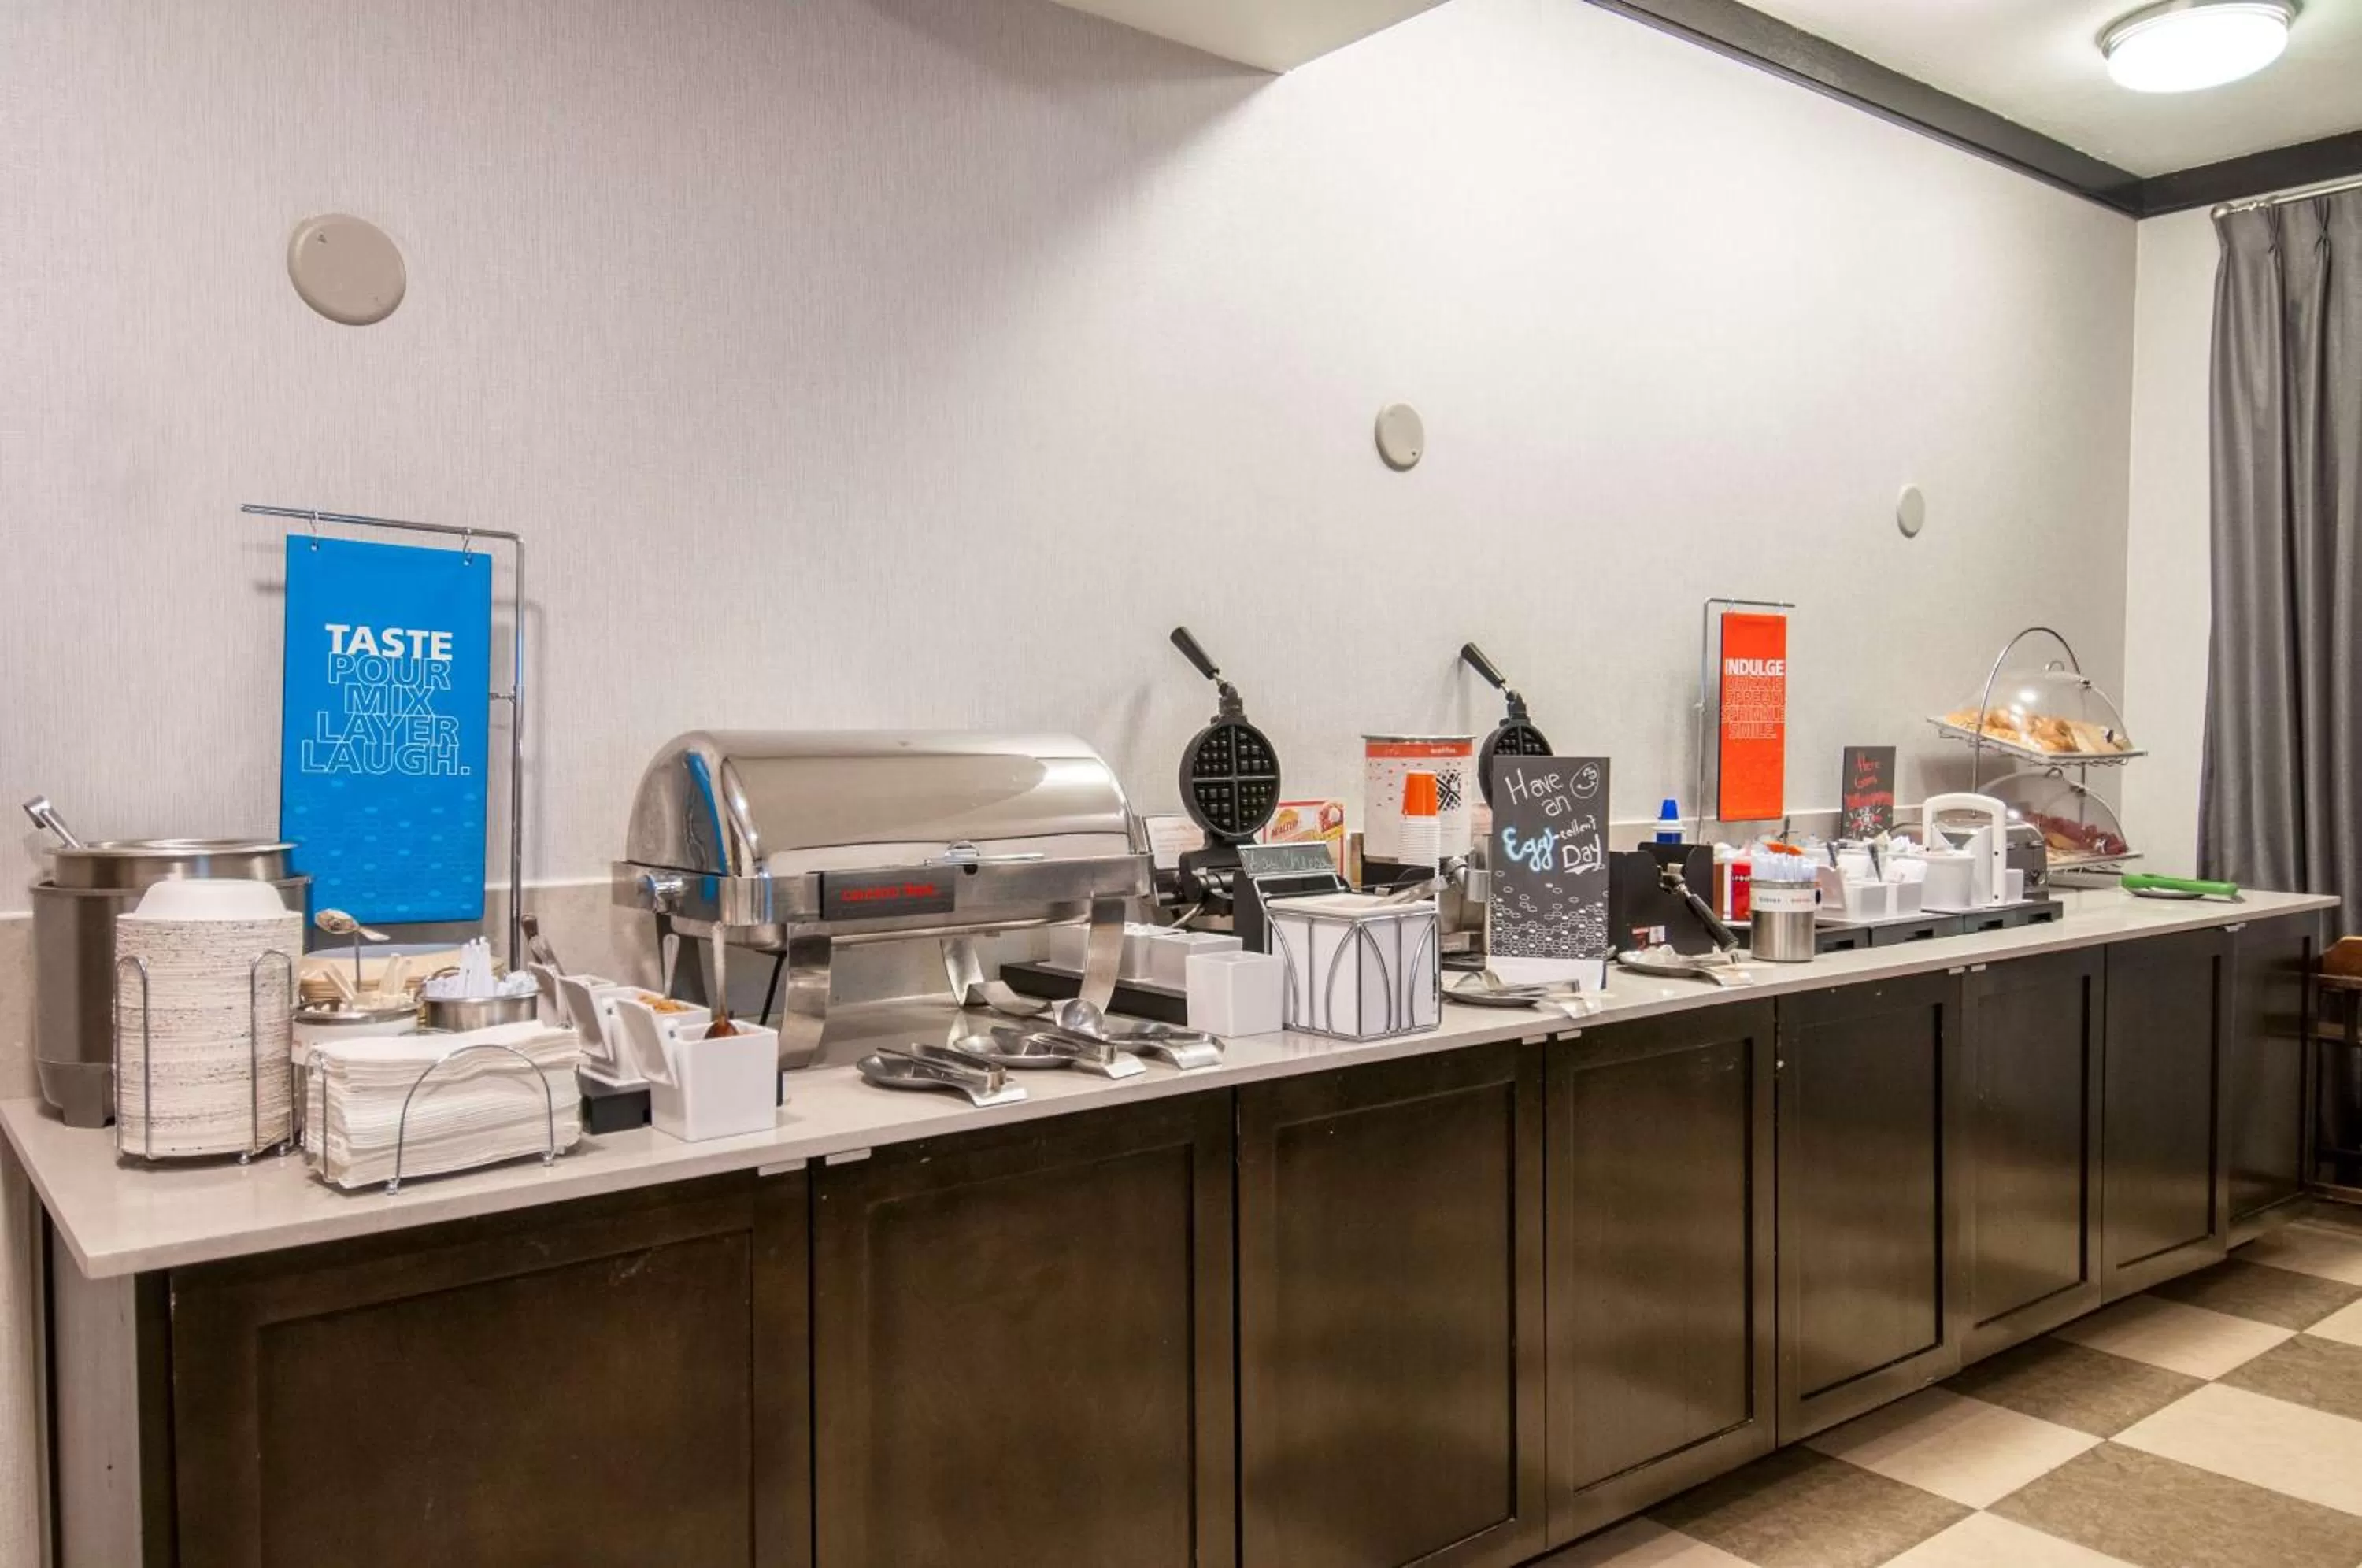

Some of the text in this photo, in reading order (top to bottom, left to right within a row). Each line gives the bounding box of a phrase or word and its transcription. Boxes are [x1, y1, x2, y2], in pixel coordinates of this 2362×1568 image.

[325, 623, 453, 661] TASTE
[328, 651, 451, 690] POUR
[1725, 658, 1785, 676] INDULGE
[344, 682, 433, 716] MIX
[317, 711, 459, 748] LAYER
[302, 739, 471, 775] LAUGH.
[1505, 767, 1563, 805] Have
[1541, 795, 1572, 816] an
[1561, 833, 1603, 872] Day
